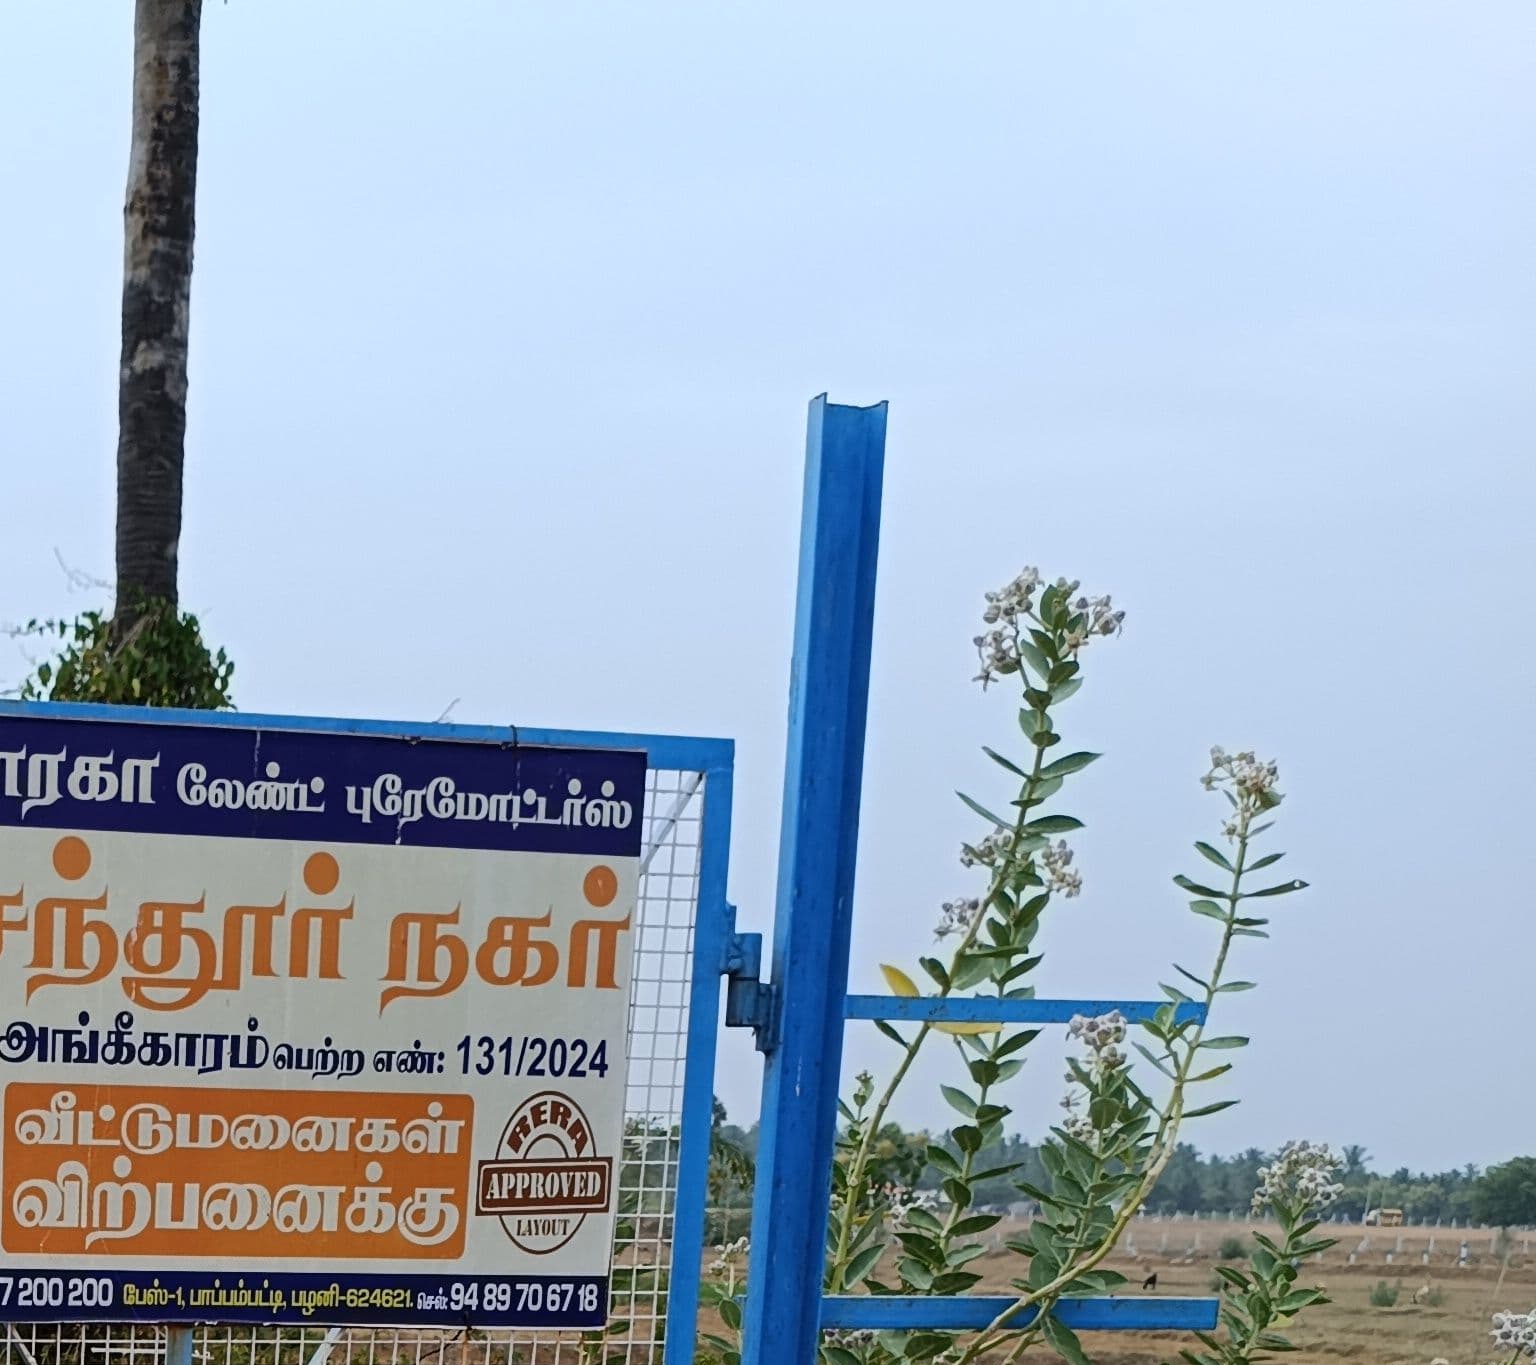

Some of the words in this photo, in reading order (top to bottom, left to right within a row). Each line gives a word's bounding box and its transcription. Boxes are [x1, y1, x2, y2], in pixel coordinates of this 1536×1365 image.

[177, 761, 326, 813] லேண்ட்
[345, 772, 633, 830] புரேமோட்டர்ஸ்
[376, 864, 633, 1018] நகர்
[272, 1036, 365, 1080] பெற்ற
[373, 1039, 446, 1075] எண்:
[456, 1034, 610, 1079] 131/2024
[14, 1090, 466, 1155] வீட்டுமனைகள்
[506, 1100, 589, 1158] RERA
[12, 1155, 461, 1250] விற்பனைக்கு
[485, 1171, 602, 1200] APPROVED
[516, 1218, 571, 1237] LAYOUT
[18, 1277, 64, 1307] 200
[68, 1278, 114, 1307] 200
[450, 1282, 479, 1311] 94
[482, 1283, 511, 1312] 89
[515, 1283, 543, 1312] 70
